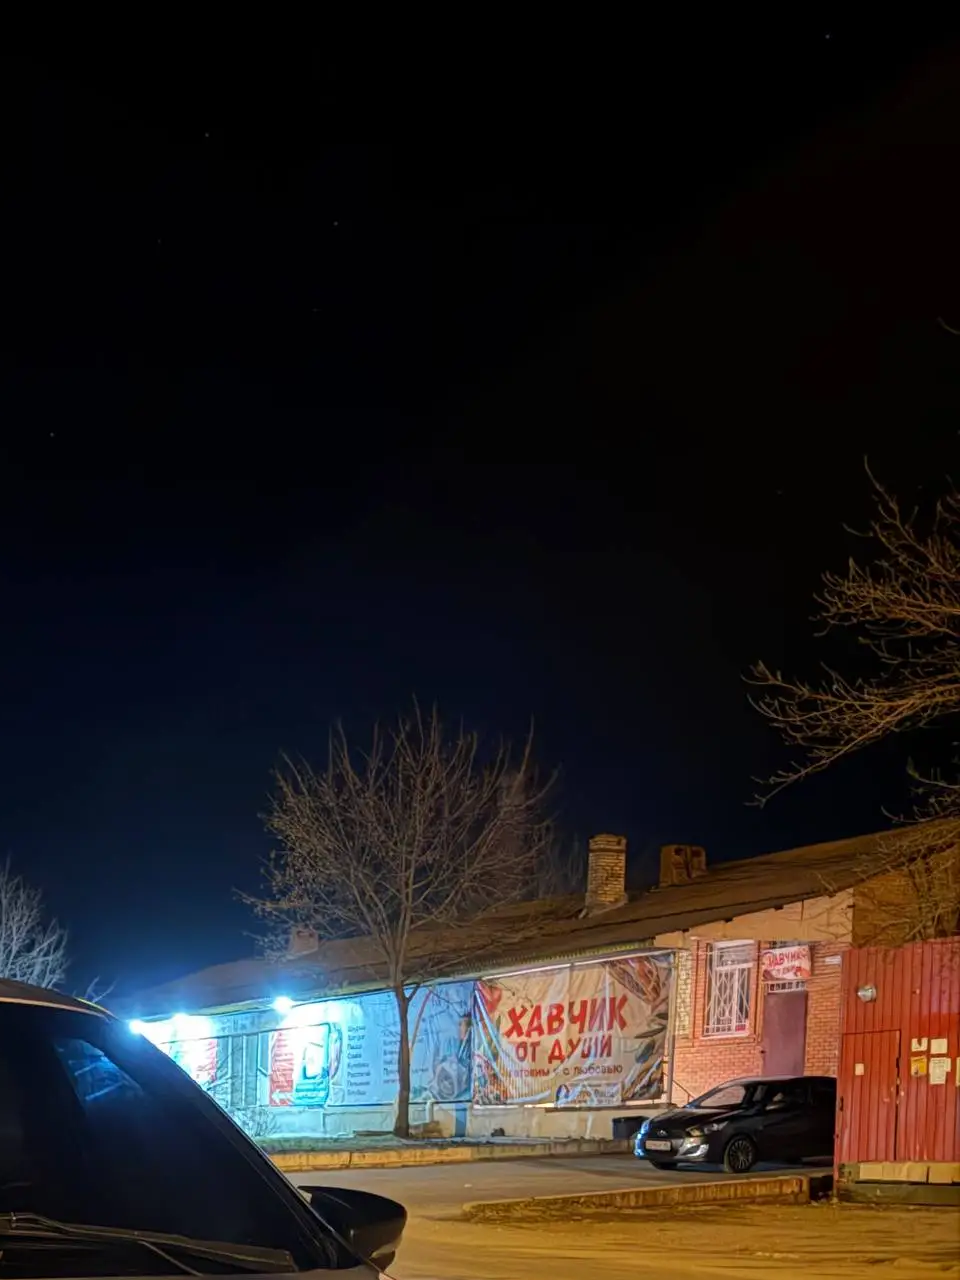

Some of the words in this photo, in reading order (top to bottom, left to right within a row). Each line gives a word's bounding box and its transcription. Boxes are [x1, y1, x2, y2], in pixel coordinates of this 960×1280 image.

[504, 994, 628, 1038] ХАВЧИК
[515, 1041, 541, 1063] ОТ
[548, 1034, 612, 1064] ДУШИ
